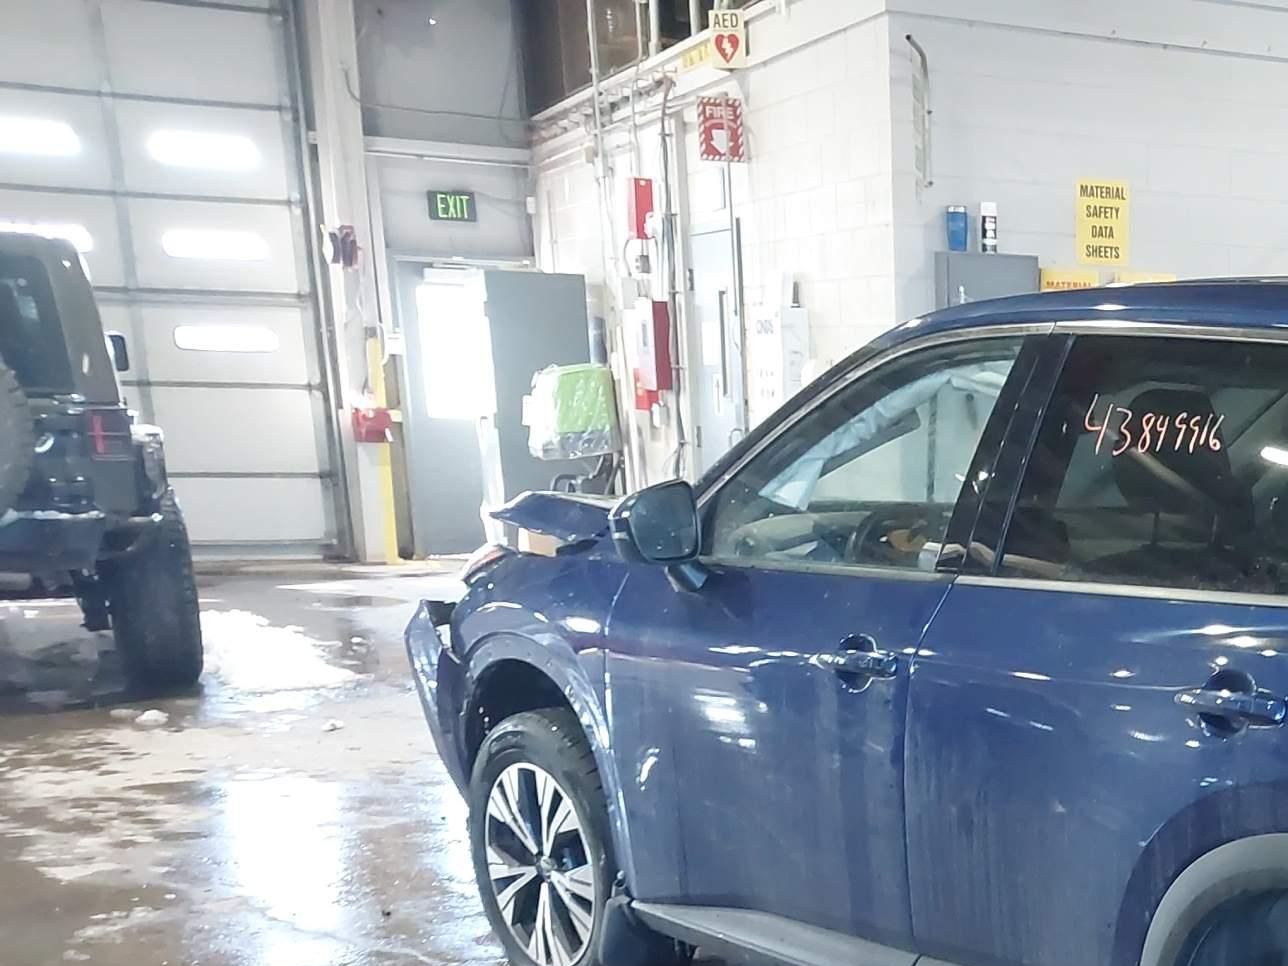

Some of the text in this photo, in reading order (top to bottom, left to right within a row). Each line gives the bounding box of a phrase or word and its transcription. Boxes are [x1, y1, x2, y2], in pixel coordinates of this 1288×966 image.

[713, 12, 739, 28] AED
[705, 106, 735, 119] FIRE
[1080, 184, 1126, 200] MATERIAL
[437, 194, 470, 219] EXIT
[1085, 204, 1120, 219] SAFETY
[1091, 225, 1114, 239] DATA
[1085, 244, 1120, 259] SHEETS
